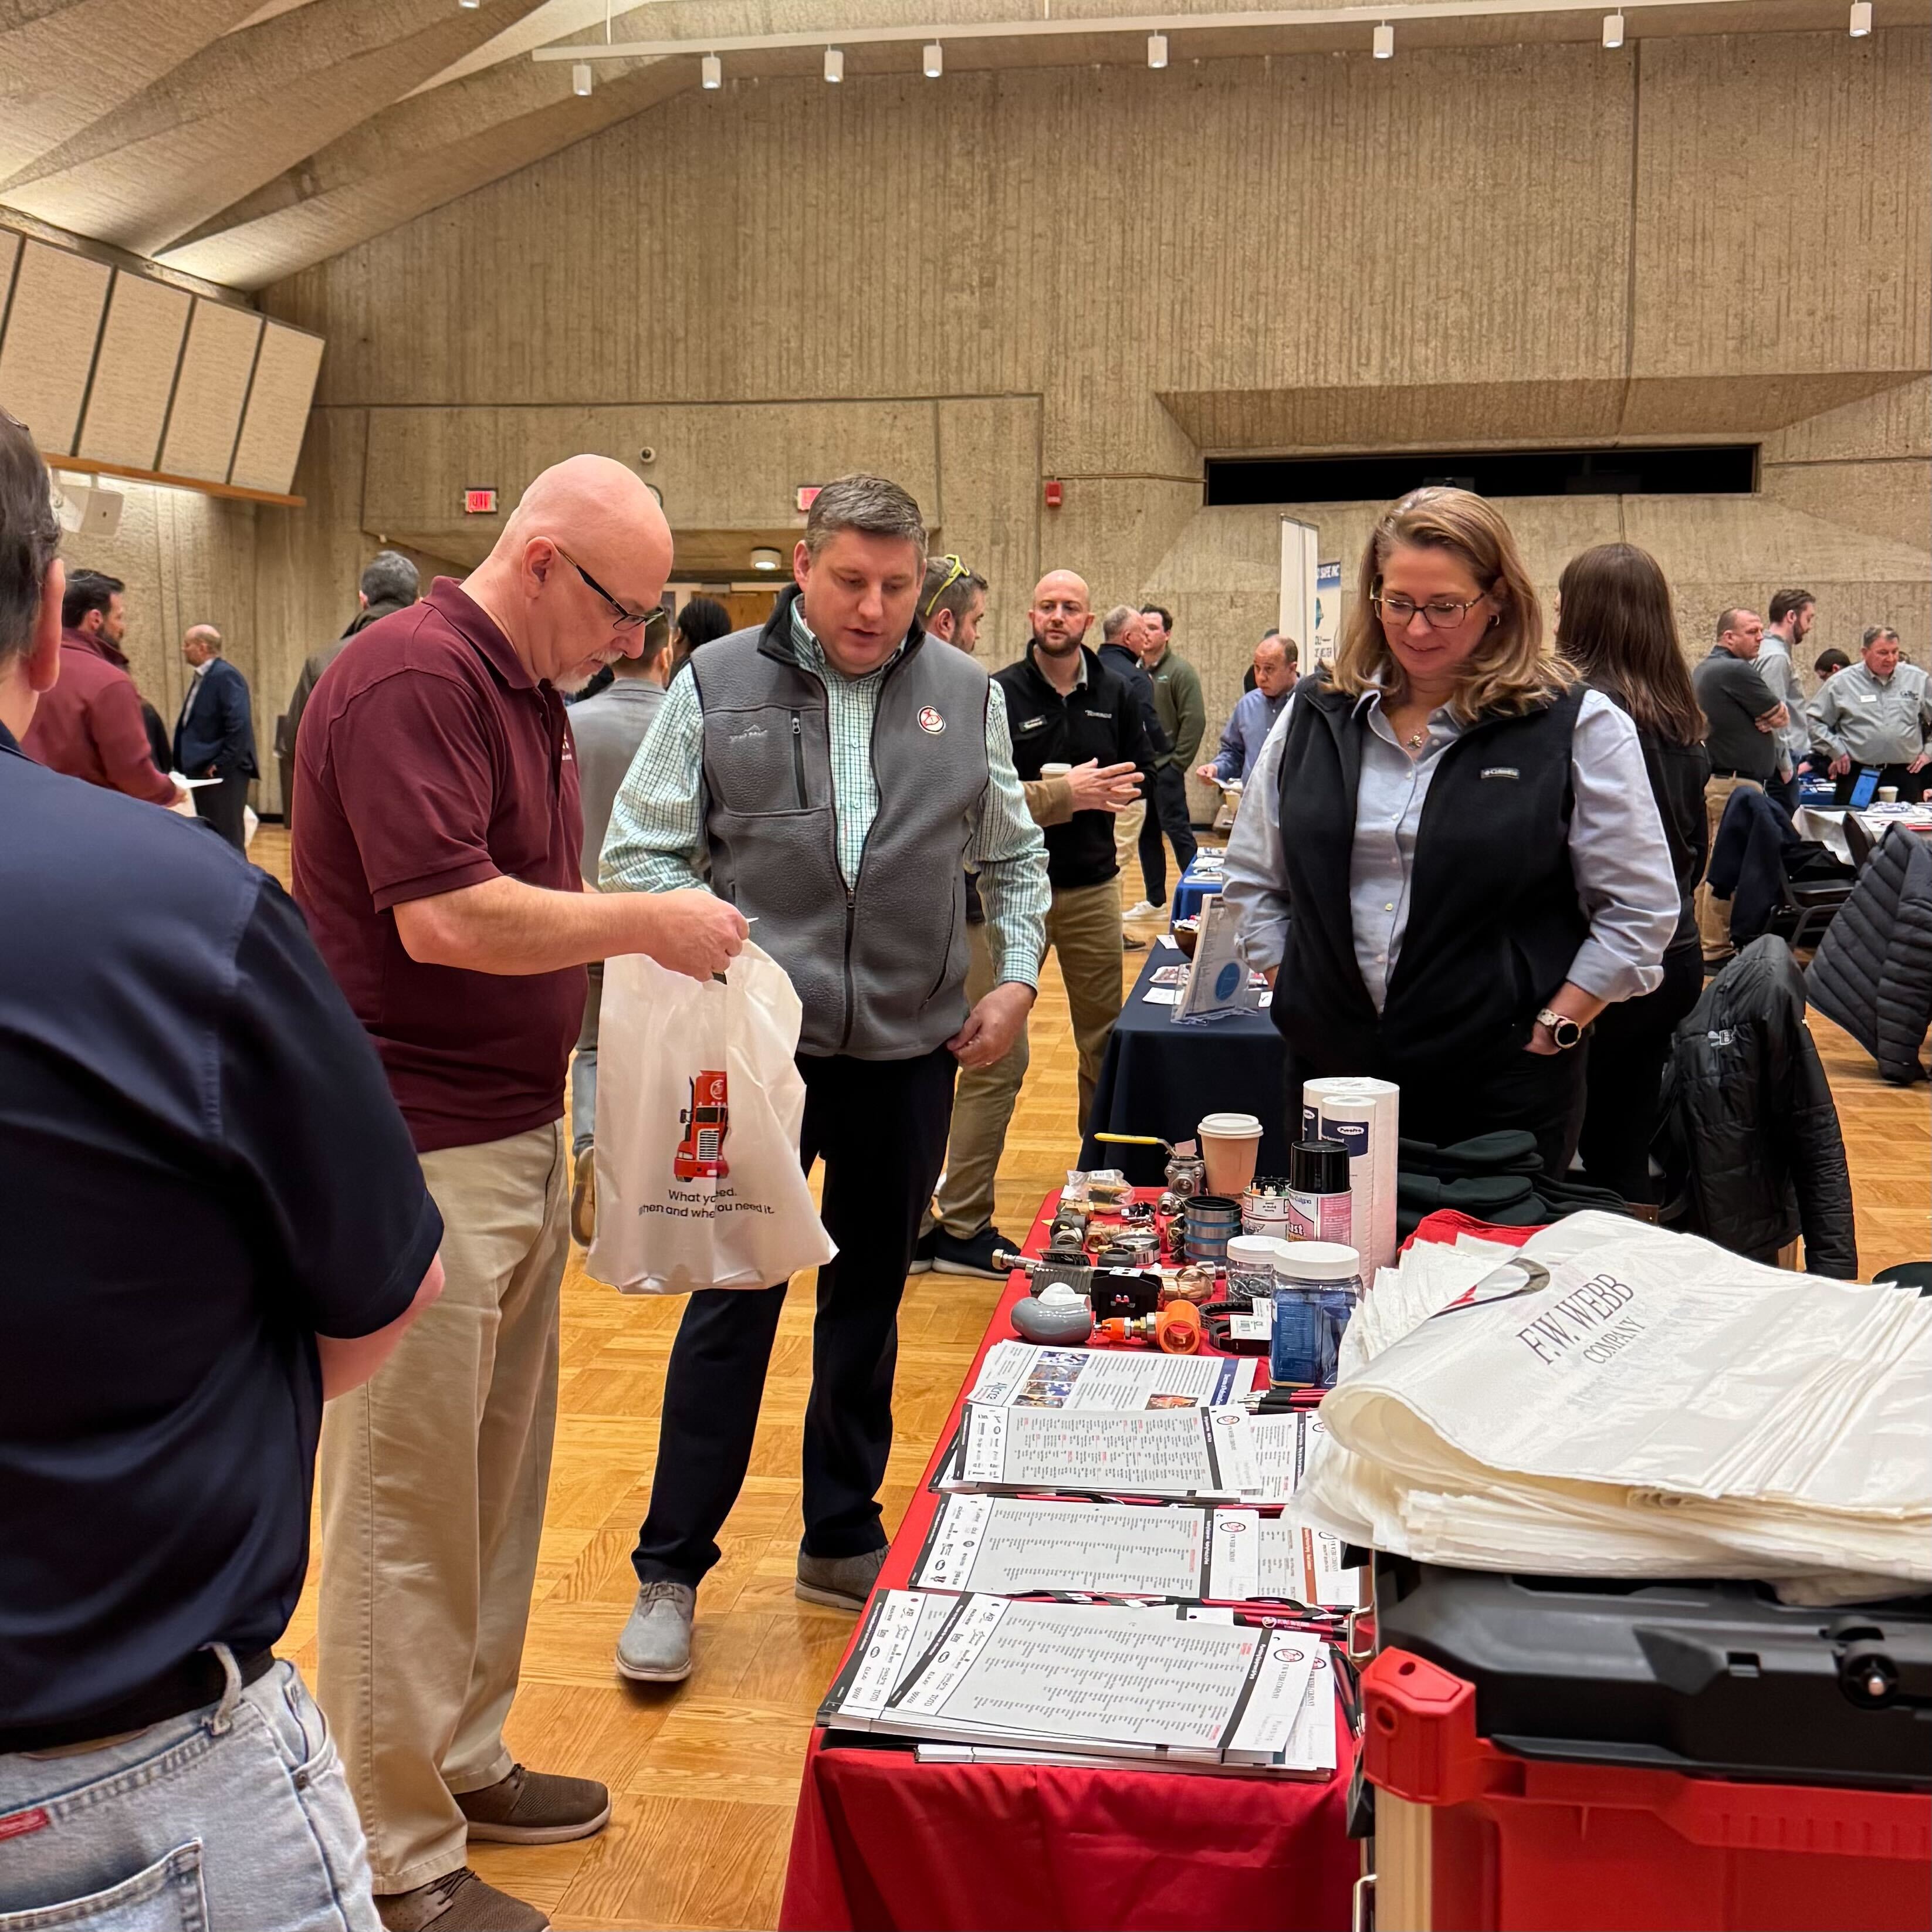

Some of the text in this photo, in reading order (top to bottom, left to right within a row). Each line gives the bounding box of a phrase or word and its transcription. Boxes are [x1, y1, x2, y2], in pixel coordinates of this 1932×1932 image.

[666, 1206, 689, 1216] and
[691, 1209, 715, 1218] whe
[735, 1203, 762, 1213] need
[668, 1187, 737, 1206] What yo ed.
[1554, 1273, 1634, 1331] WEBB
[1584, 1316, 1646, 1364] COMPANY
